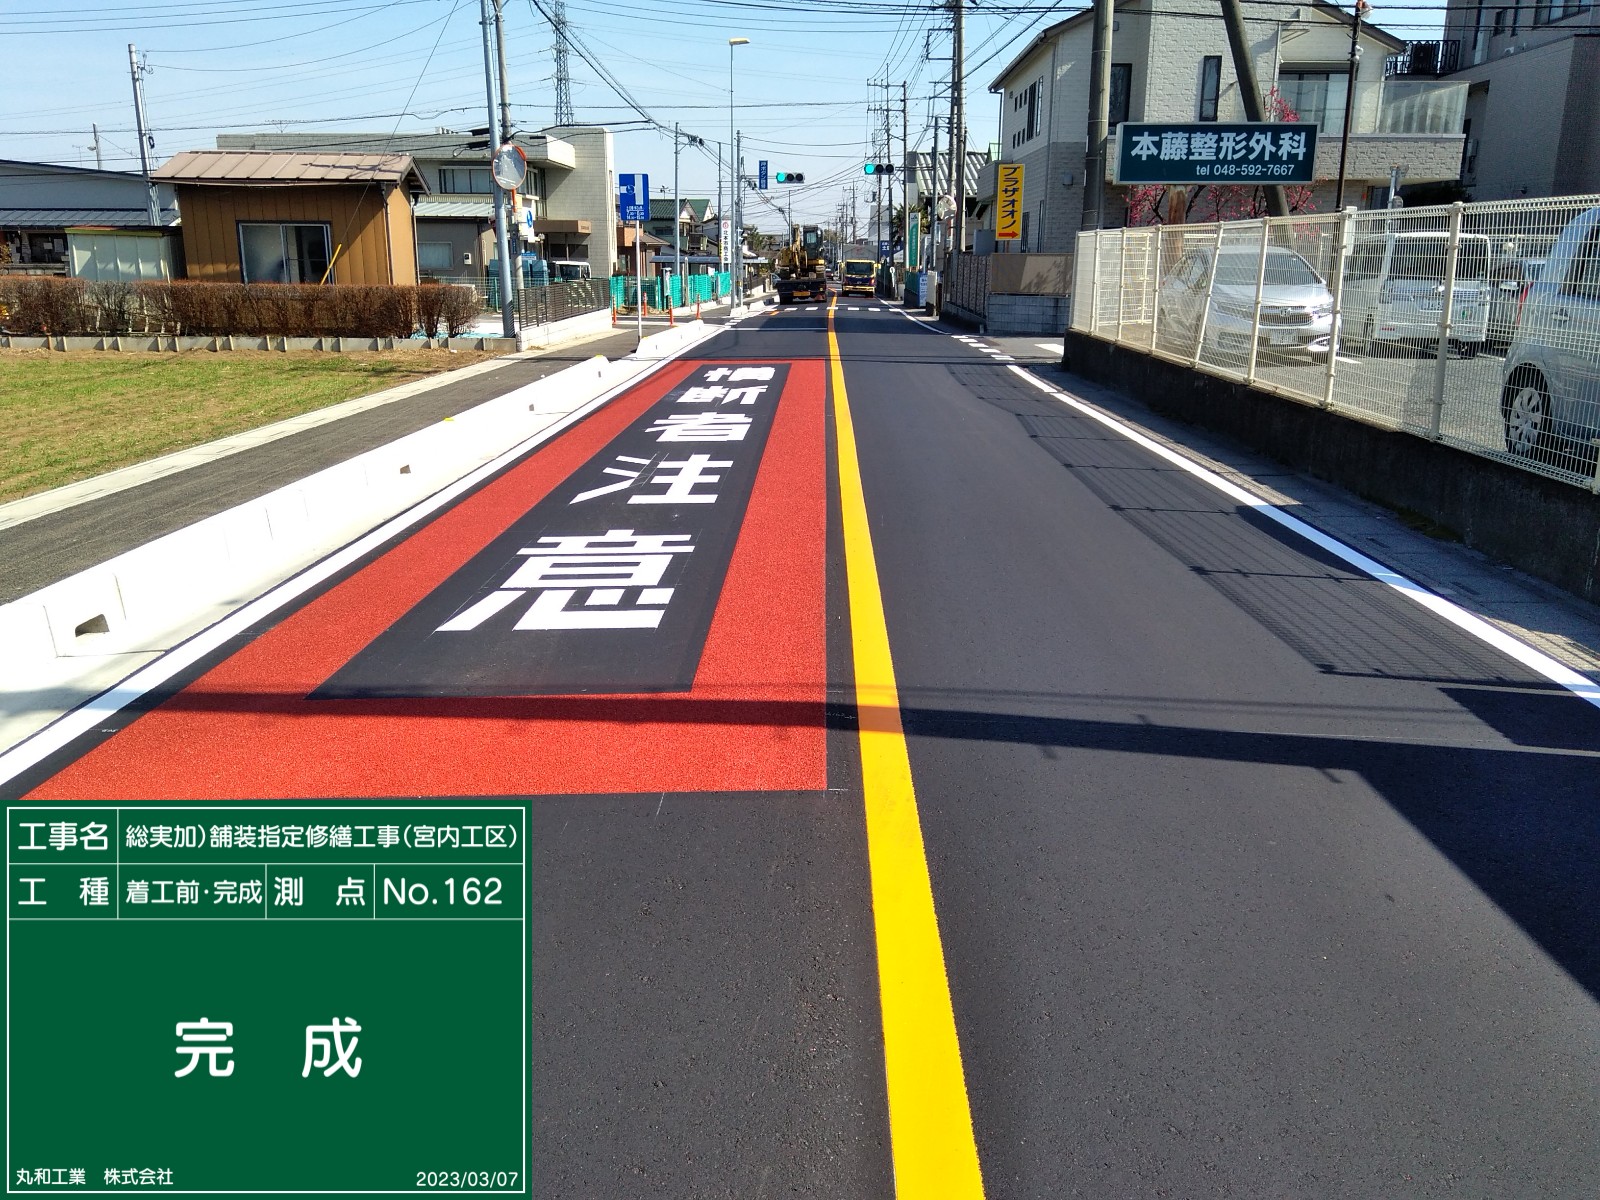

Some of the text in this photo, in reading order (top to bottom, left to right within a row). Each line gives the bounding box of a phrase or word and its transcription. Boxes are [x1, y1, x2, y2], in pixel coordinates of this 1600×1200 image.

[1130, 131, 1307, 161] 本藤整形外科
[1196, 164, 1295, 176] tel 048-592-7667
